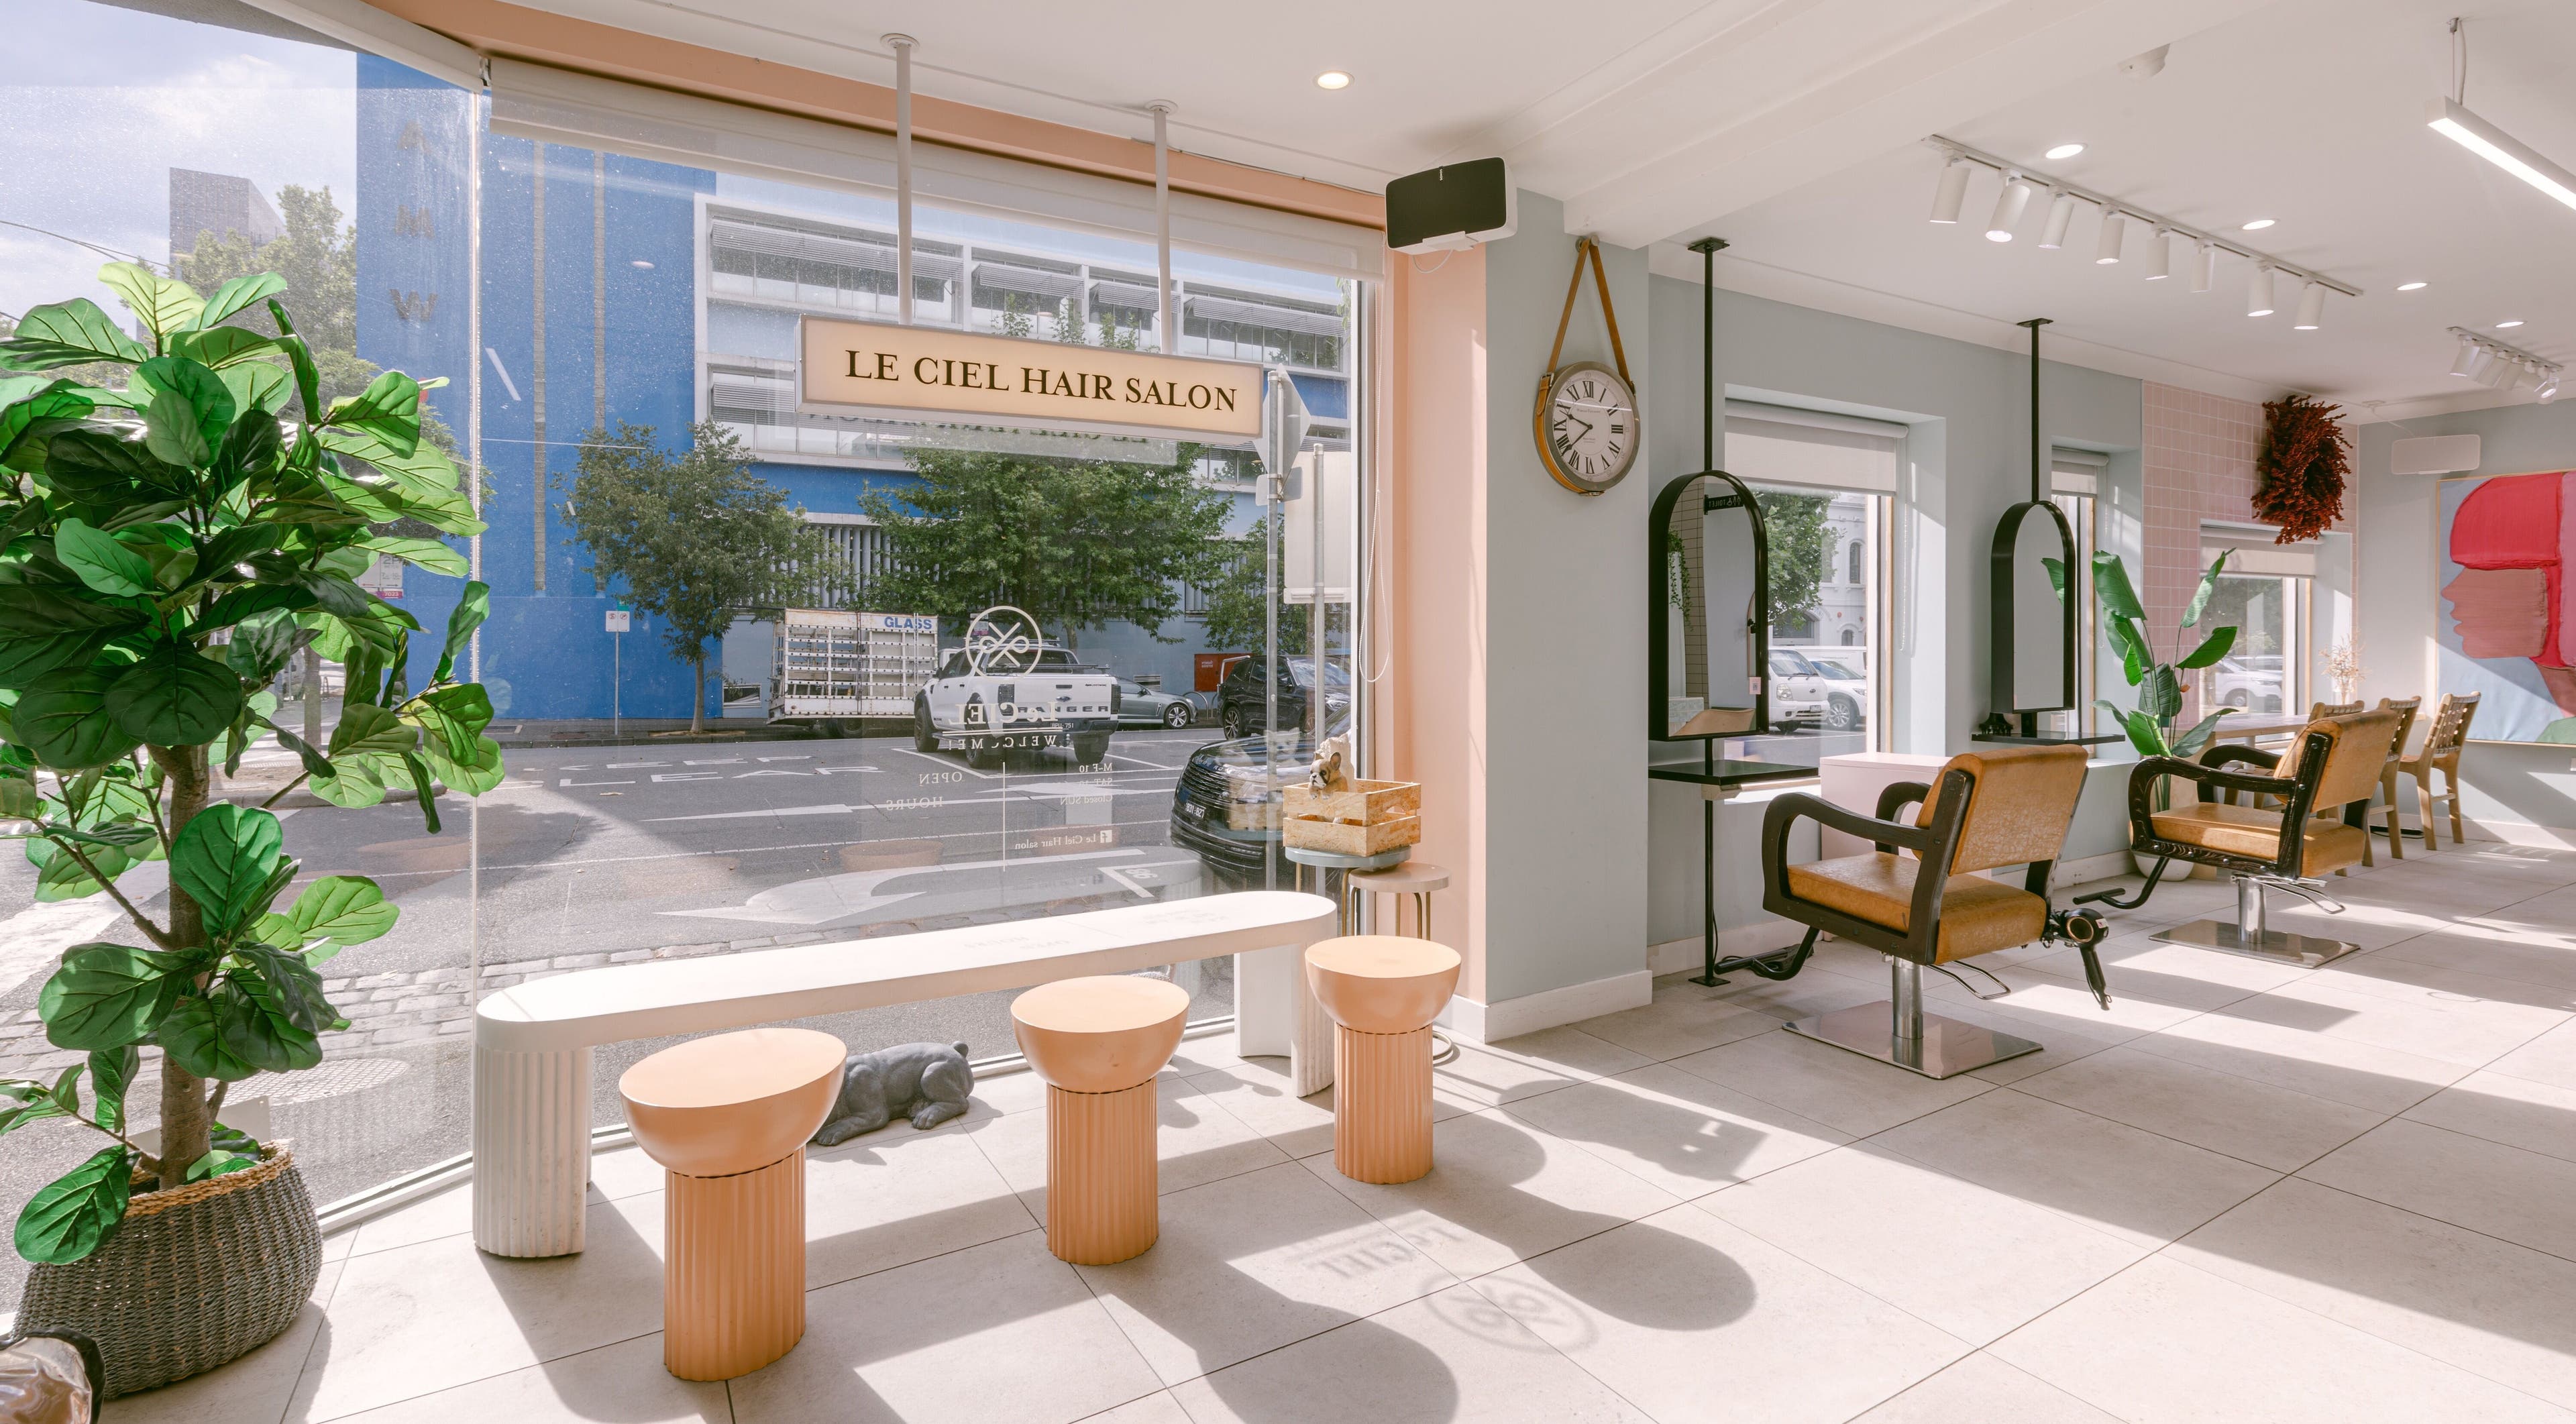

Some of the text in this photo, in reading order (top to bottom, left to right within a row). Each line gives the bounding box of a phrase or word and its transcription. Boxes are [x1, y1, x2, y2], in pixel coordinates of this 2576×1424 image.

[845, 349, 1237, 412] LE CIEL HAIR SALON
[1582, 380, 1594, 398] XII
[1611, 424, 1623, 434] III
[884, 616, 932, 629] GLASS
